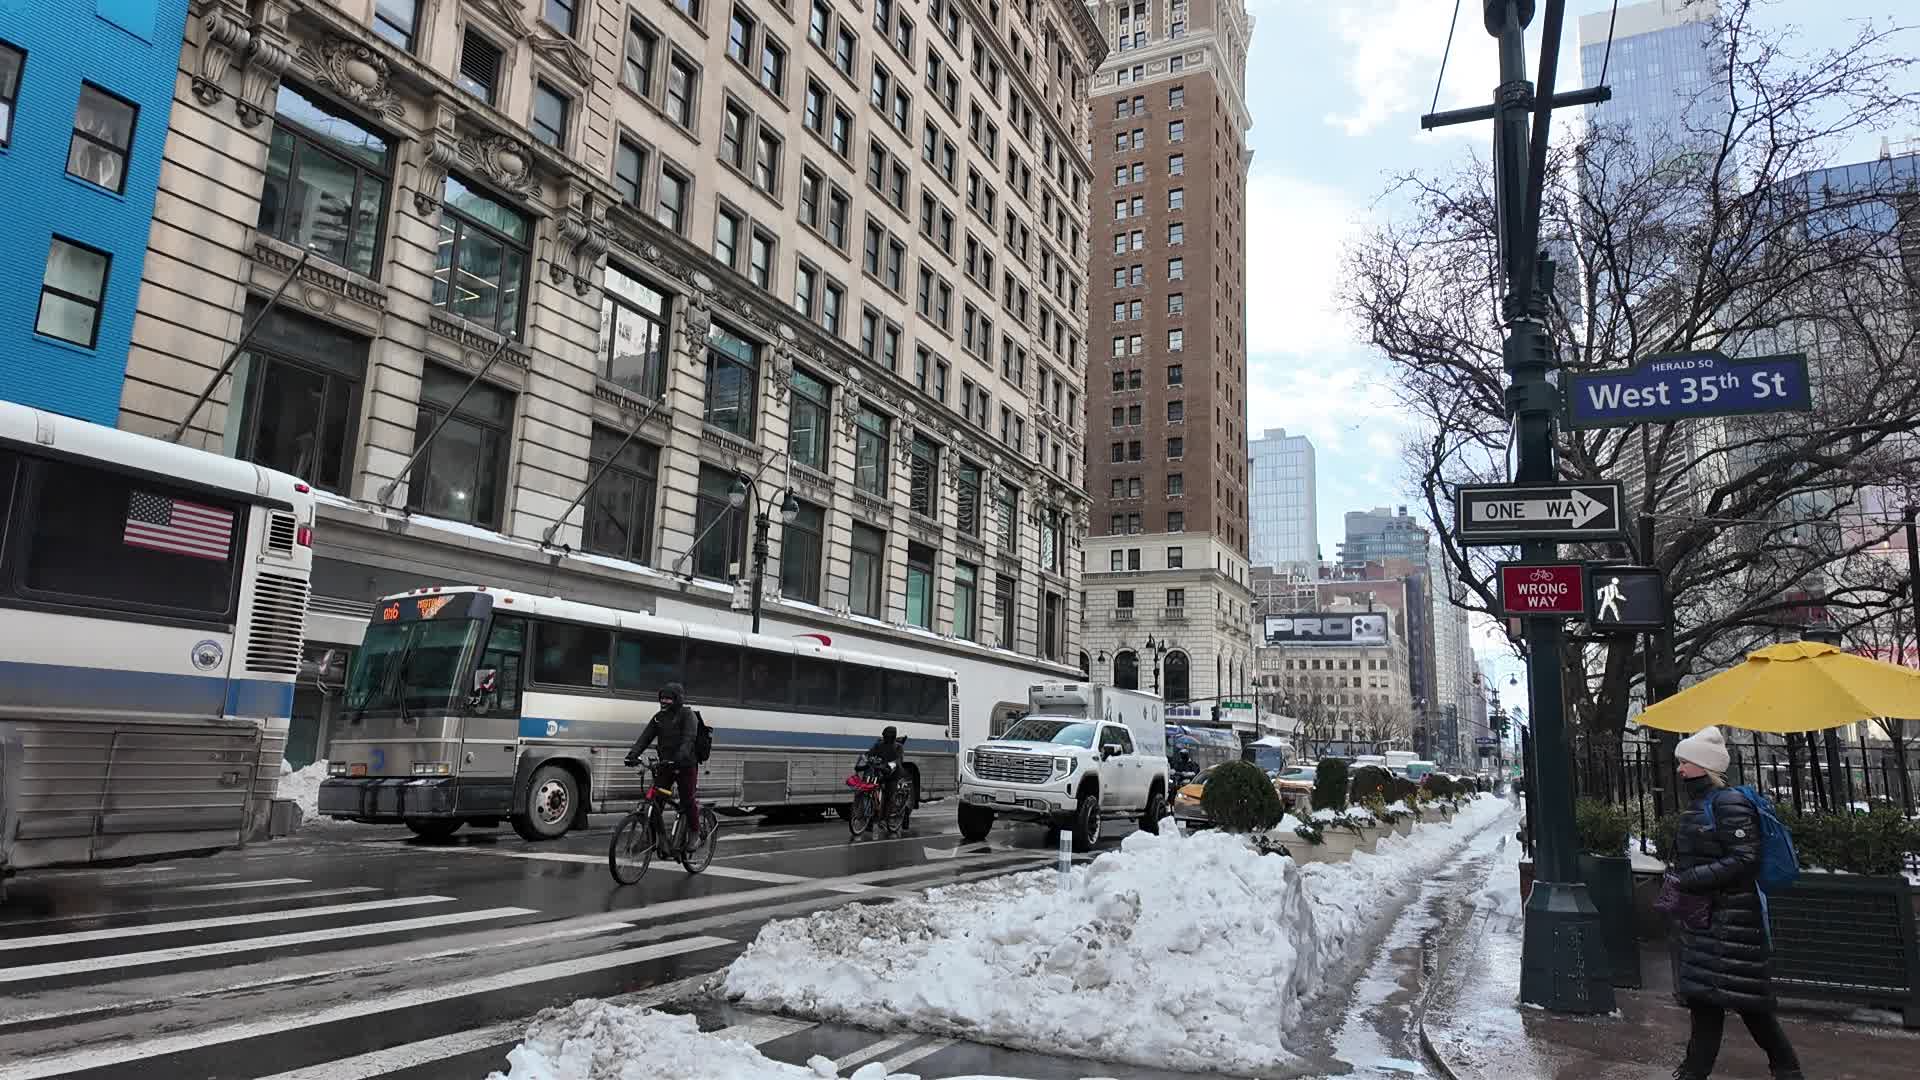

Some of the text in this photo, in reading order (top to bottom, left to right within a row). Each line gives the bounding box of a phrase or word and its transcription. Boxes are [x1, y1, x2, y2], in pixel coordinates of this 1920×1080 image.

[1652, 358, 1714, 372] HERALD SQ
[1587, 371, 1788, 410] West 35th St
[1485, 500, 1592, 519] ONE WAY
[1517, 582, 1569, 595] WRONG
[1527, 595, 1558, 608] WAY
